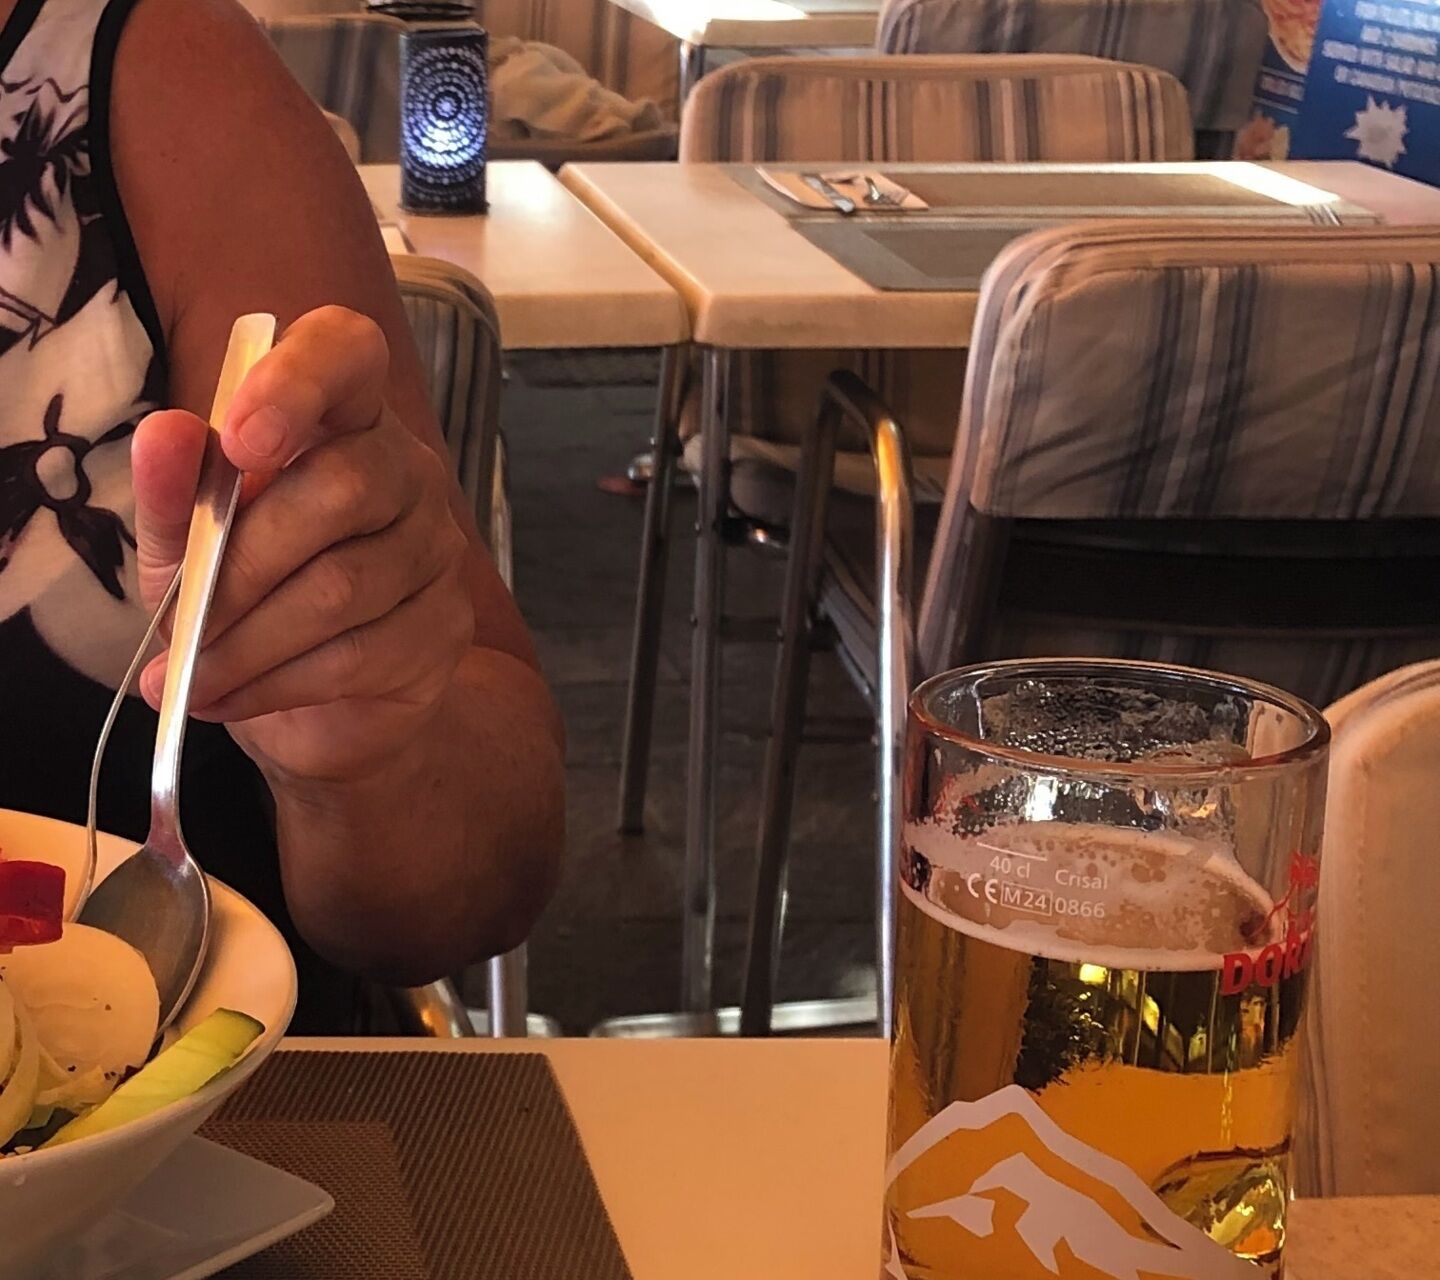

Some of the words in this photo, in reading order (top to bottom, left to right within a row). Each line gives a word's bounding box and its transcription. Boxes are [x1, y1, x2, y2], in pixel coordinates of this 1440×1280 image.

[990, 855, 1011, 874] 40
[1016, 862, 1030, 878] cl
[1055, 869, 1108, 890] Crisal
[1004, 886, 1047, 910] M24
[1054, 897, 1105, 918] 0866
